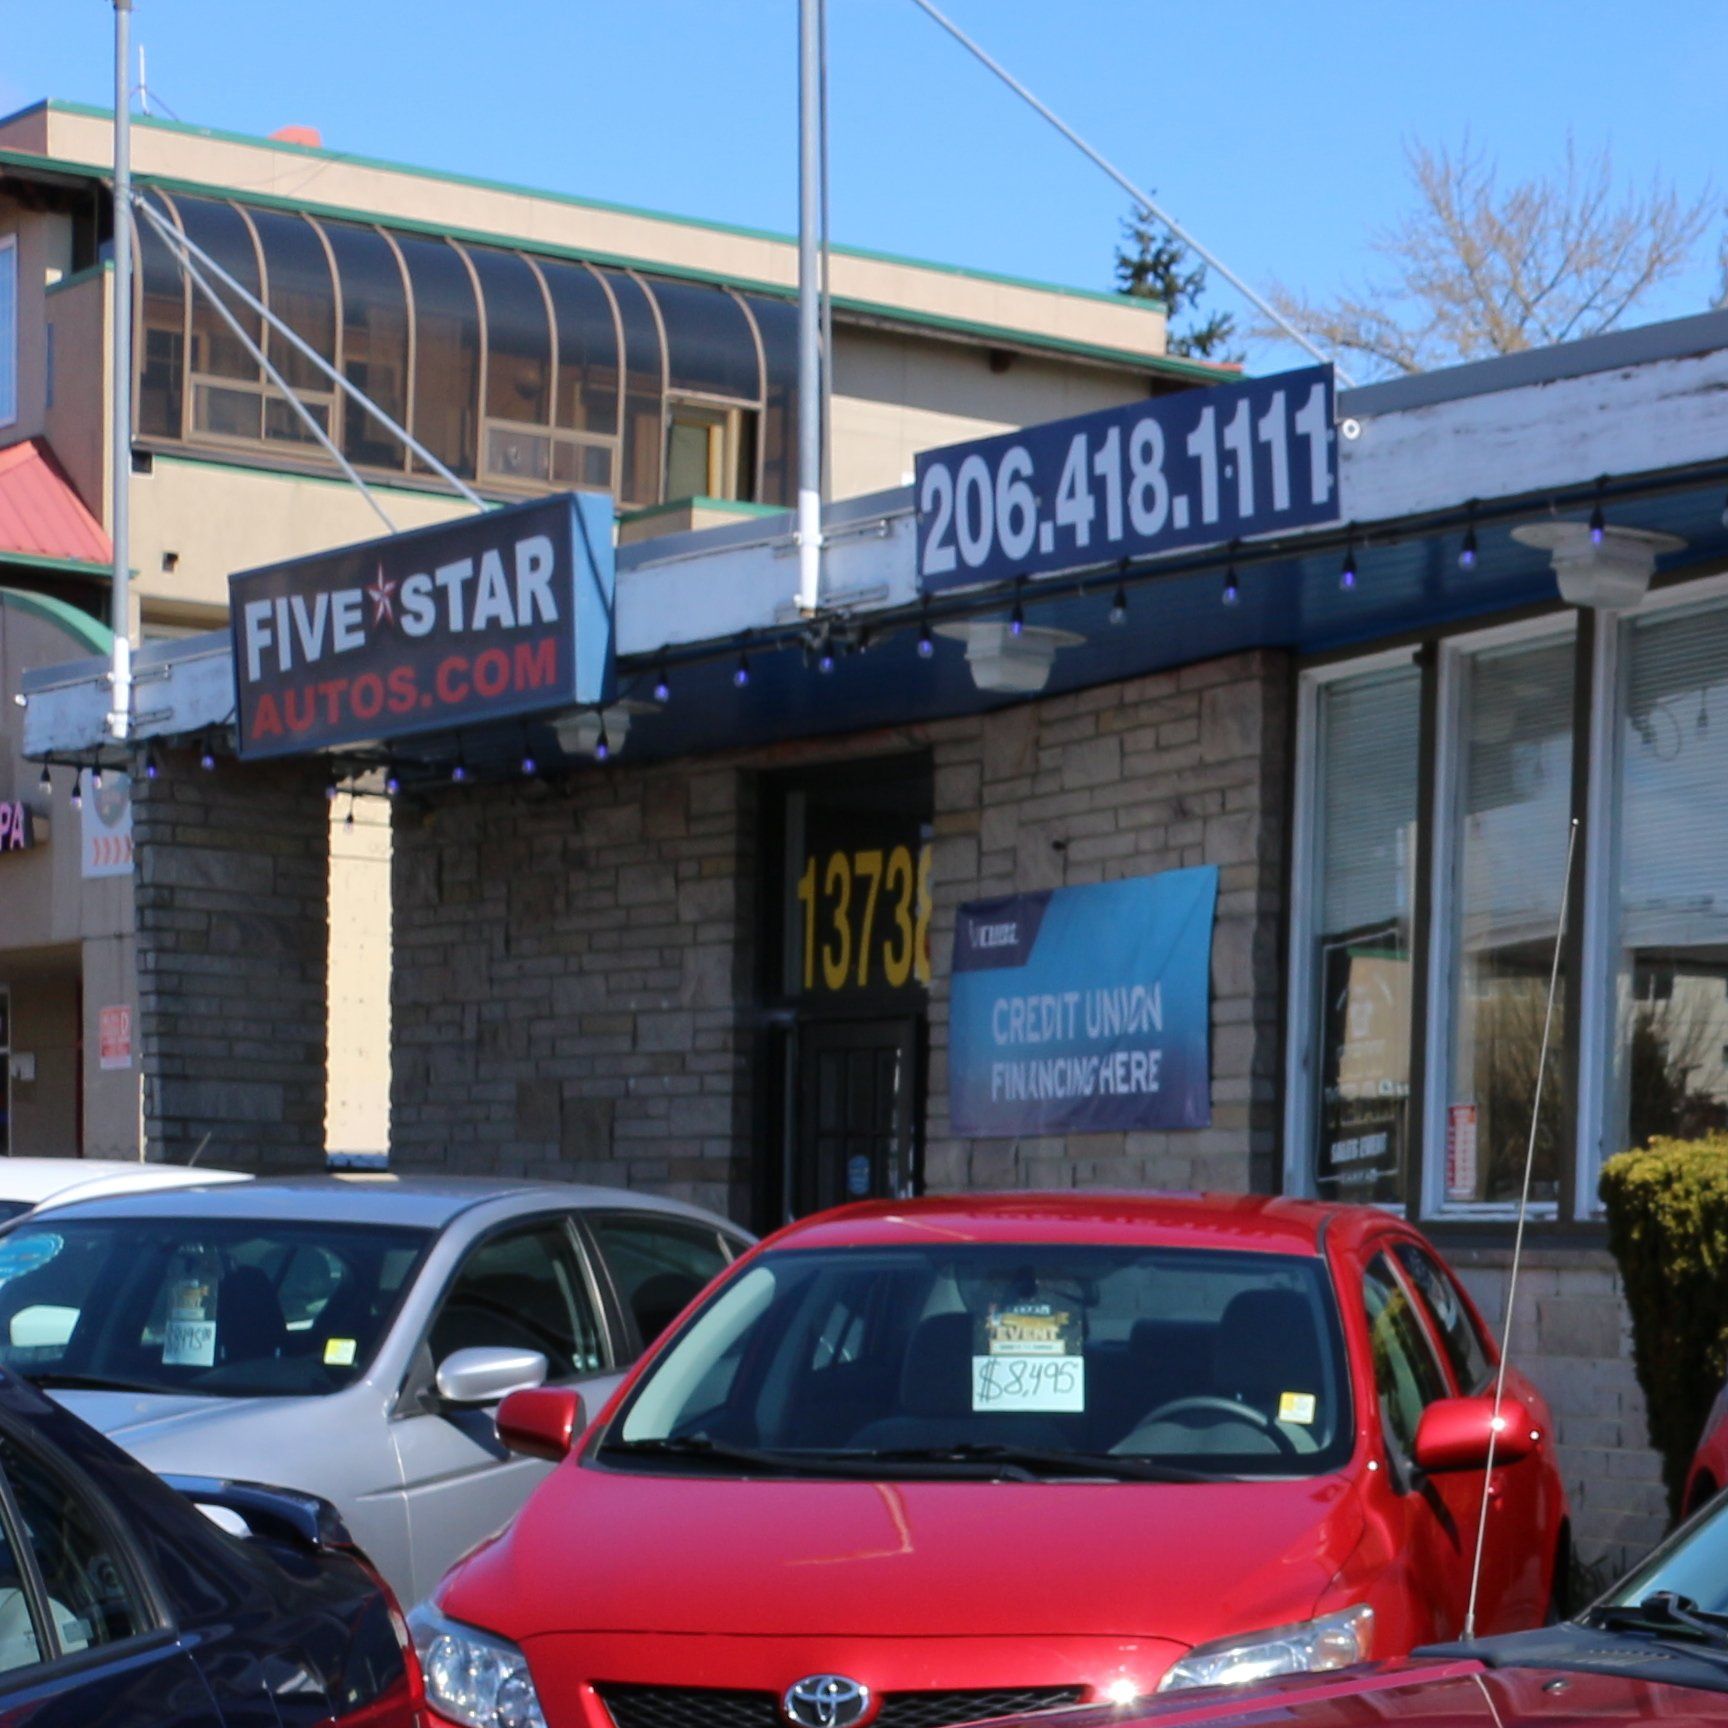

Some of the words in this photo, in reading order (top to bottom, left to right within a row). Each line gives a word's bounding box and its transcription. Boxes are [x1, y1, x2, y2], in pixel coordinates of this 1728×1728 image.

[920, 380, 1332, 576] 206.418.1111
[244, 586, 366, 684] FIVE
[399, 534, 559, 638] STAR
[250, 637, 557, 740] AUTOS.COM
[991, 990, 1080, 1046] CREDIT
[1084, 981, 1164, 1040] UNION
[991, 1053, 1101, 1104] FINANCING
[1098, 1048, 1163, 1095] HERE
[976, 1358, 1079, 1403] $8,495
